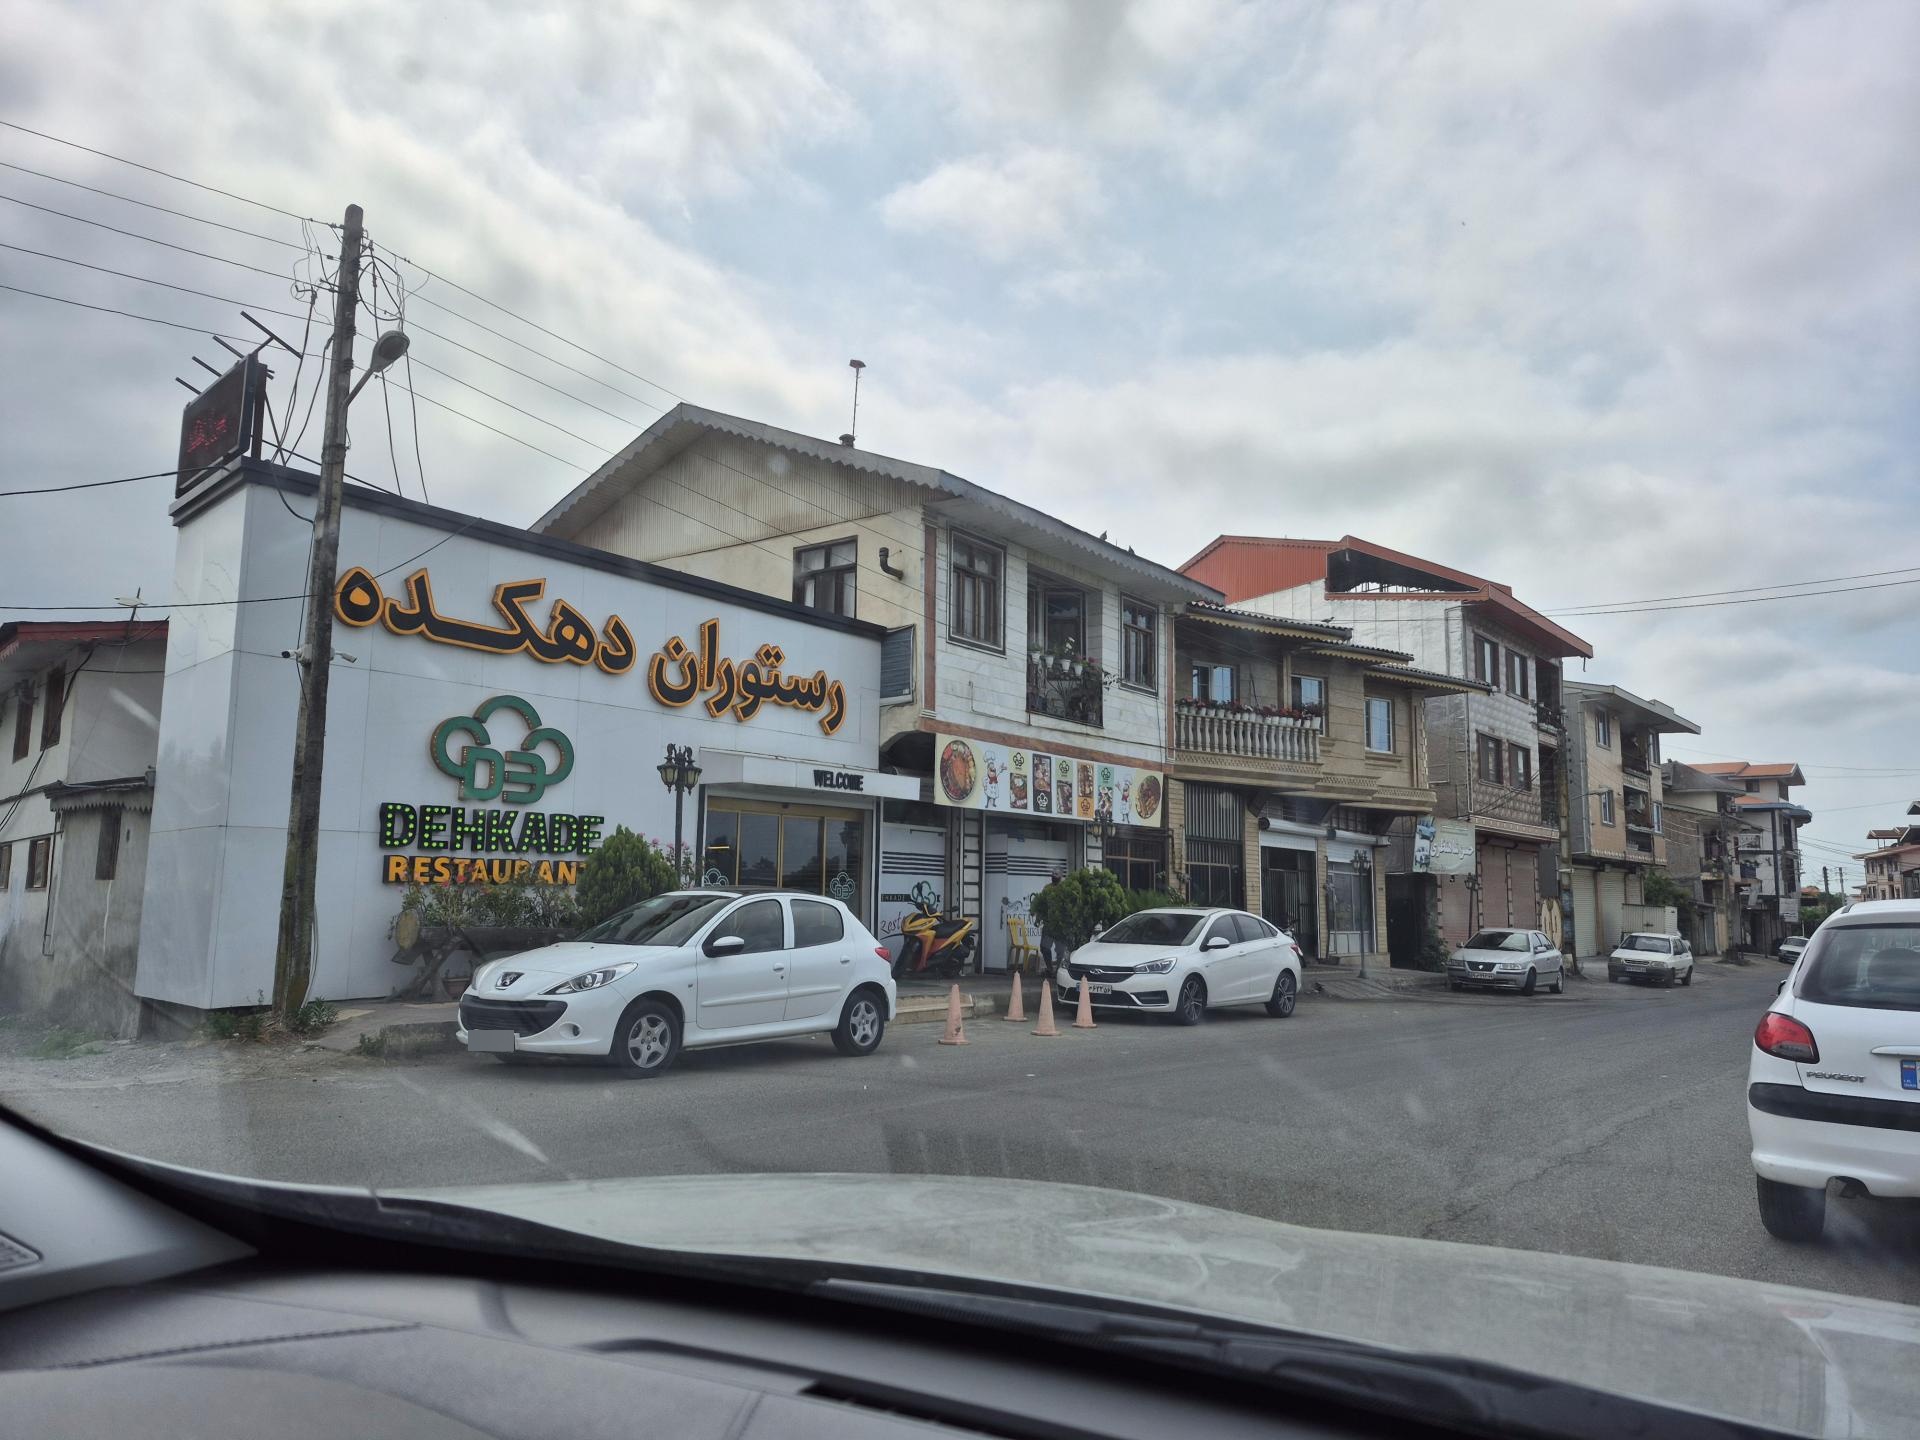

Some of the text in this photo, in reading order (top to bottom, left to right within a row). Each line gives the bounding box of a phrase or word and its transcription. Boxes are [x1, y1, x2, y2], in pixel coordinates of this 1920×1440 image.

[334, 566, 846, 735] رستوران دهکده
[813, 769, 864, 792] WELCOME
[379, 802, 605, 857] DEHKADE
[383, 854, 588, 887] RESTAURAN
[1806, 1071, 1867, 1083] PEUGEOT
